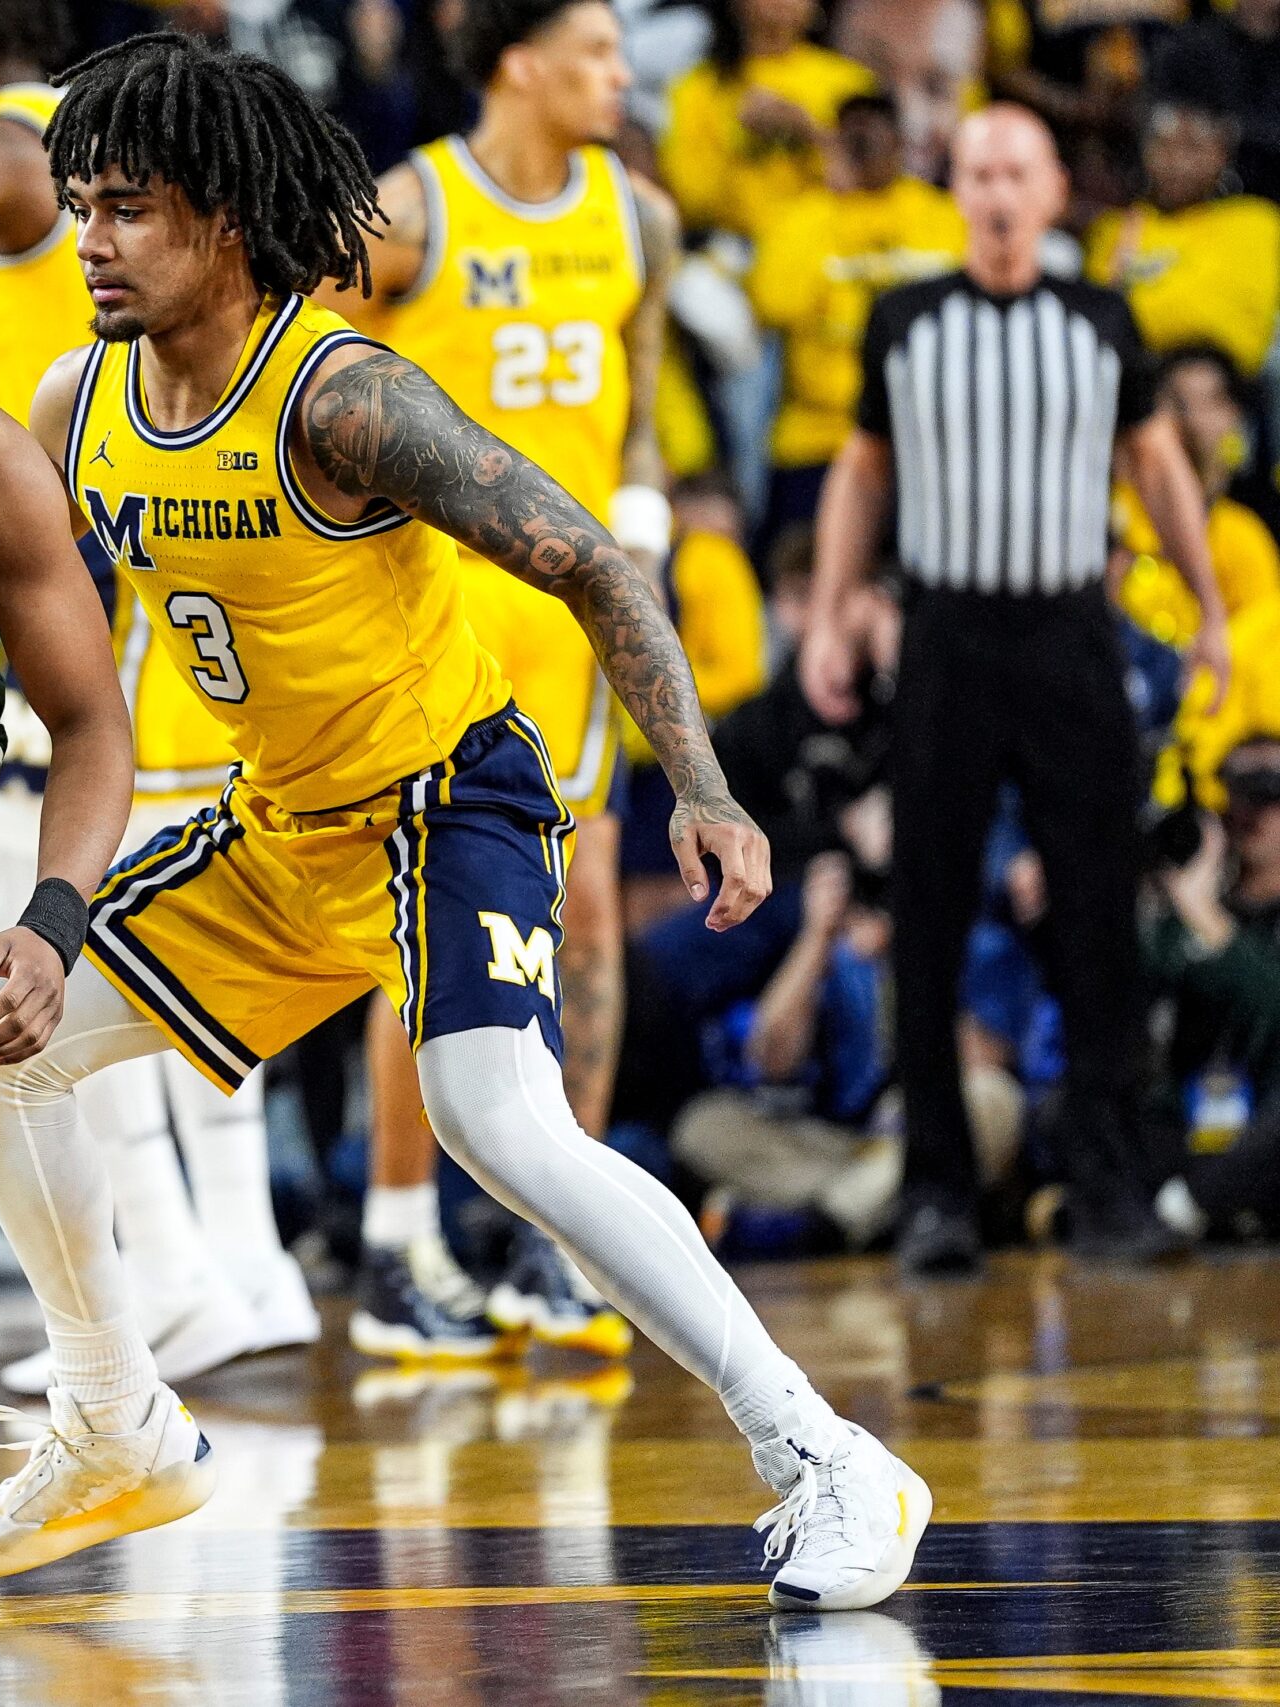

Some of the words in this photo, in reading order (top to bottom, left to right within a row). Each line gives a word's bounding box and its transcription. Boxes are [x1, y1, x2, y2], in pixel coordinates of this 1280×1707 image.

[490, 319, 605, 411] 23
[84, 486, 282, 571] MICHIGAN
[165, 591, 250, 704] 3
[477, 910, 556, 1013] M
